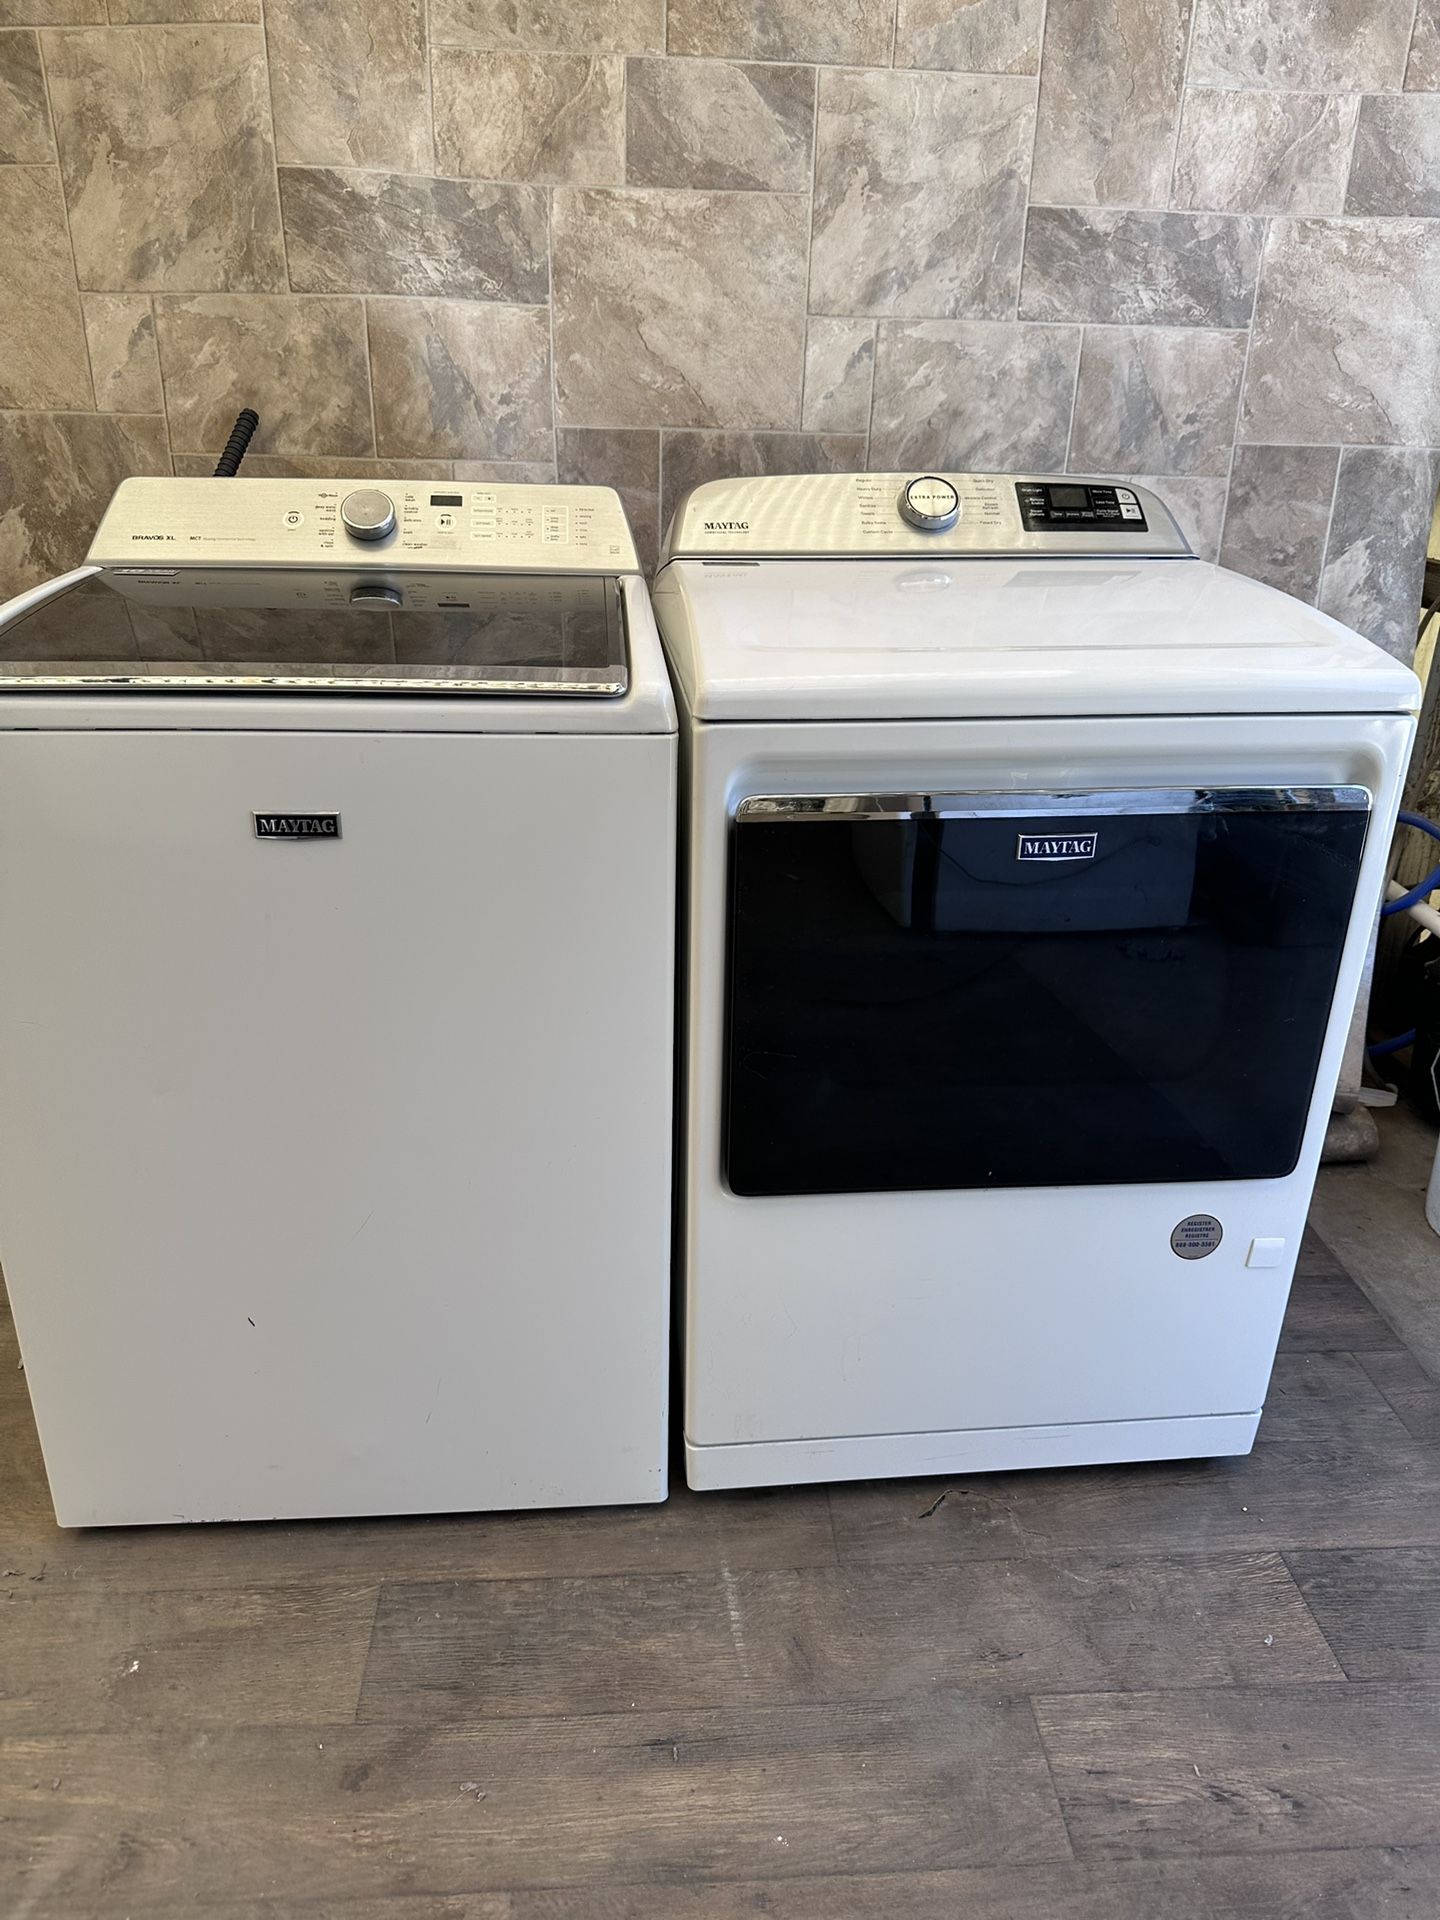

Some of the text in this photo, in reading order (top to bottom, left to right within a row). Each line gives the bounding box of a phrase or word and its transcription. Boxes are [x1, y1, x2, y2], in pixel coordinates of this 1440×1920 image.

[704, 522, 749, 530] MAYTAG
[260, 819, 335, 833] MAYTAG
[1023, 840, 1092, 855] MAYTAG
